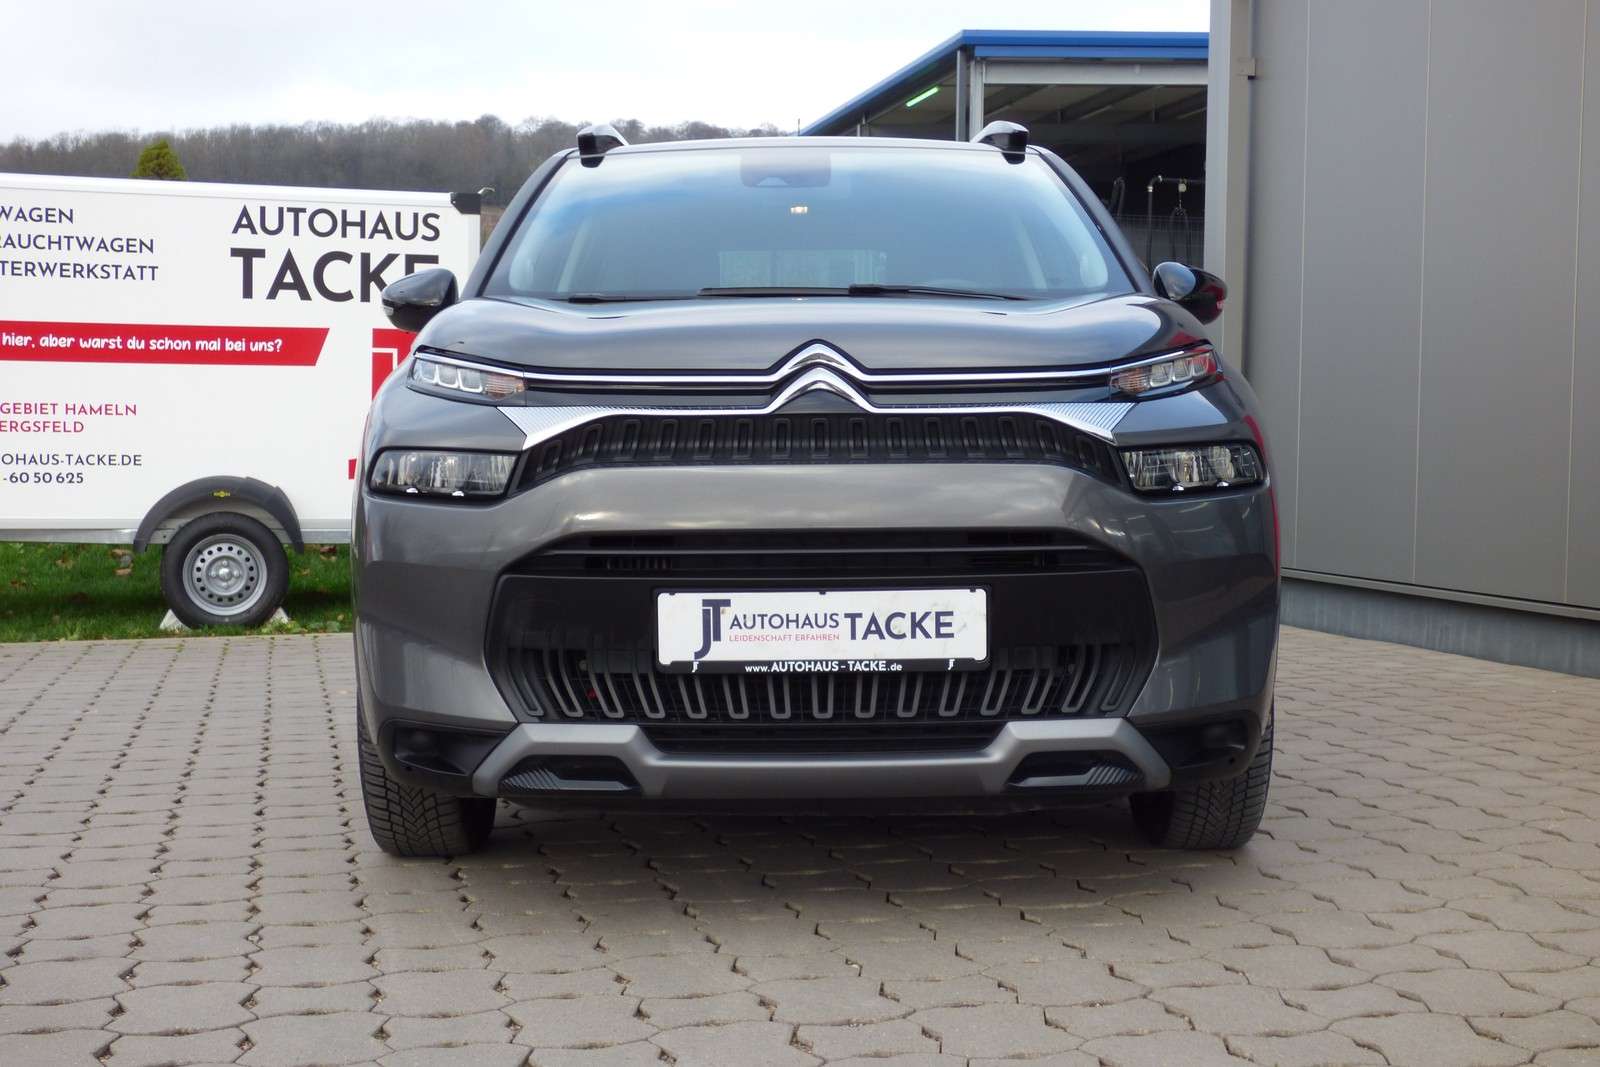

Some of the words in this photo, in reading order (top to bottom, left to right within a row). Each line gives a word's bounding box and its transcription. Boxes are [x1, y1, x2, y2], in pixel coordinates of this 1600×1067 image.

[0, 206, 74, 224] WAGEN
[231, 204, 441, 242] AUTOHAUS
[0, 233, 154, 255] AUCHTWAGEN
[0, 260, 159, 281] TERWERKSTATT
[1, 332, 34, 349] hier,
[39, 333, 75, 349] aber
[79, 335, 123, 350] warst
[126, 335, 145, 351] du
[149, 336, 192, 352] schon
[195, 337, 221, 352] mal
[224, 337, 246, 352] bei
[249, 338, 283, 353] uns?
[0, 402, 59, 416] GEBIET
[64, 402, 137, 417] HAMELN
[1, 453, 143, 467] OHAUS-TACKE.DE
[33, 471, 53, 485] 50
[55, 471, 84, 485] 625
[729, 613, 840, 630] AUTOHAUS
[844, 610, 955, 641] TACKE
[729, 634, 792, 642] LEIDENSCHAFT
[795, 633, 840, 641] ERFAHREN
